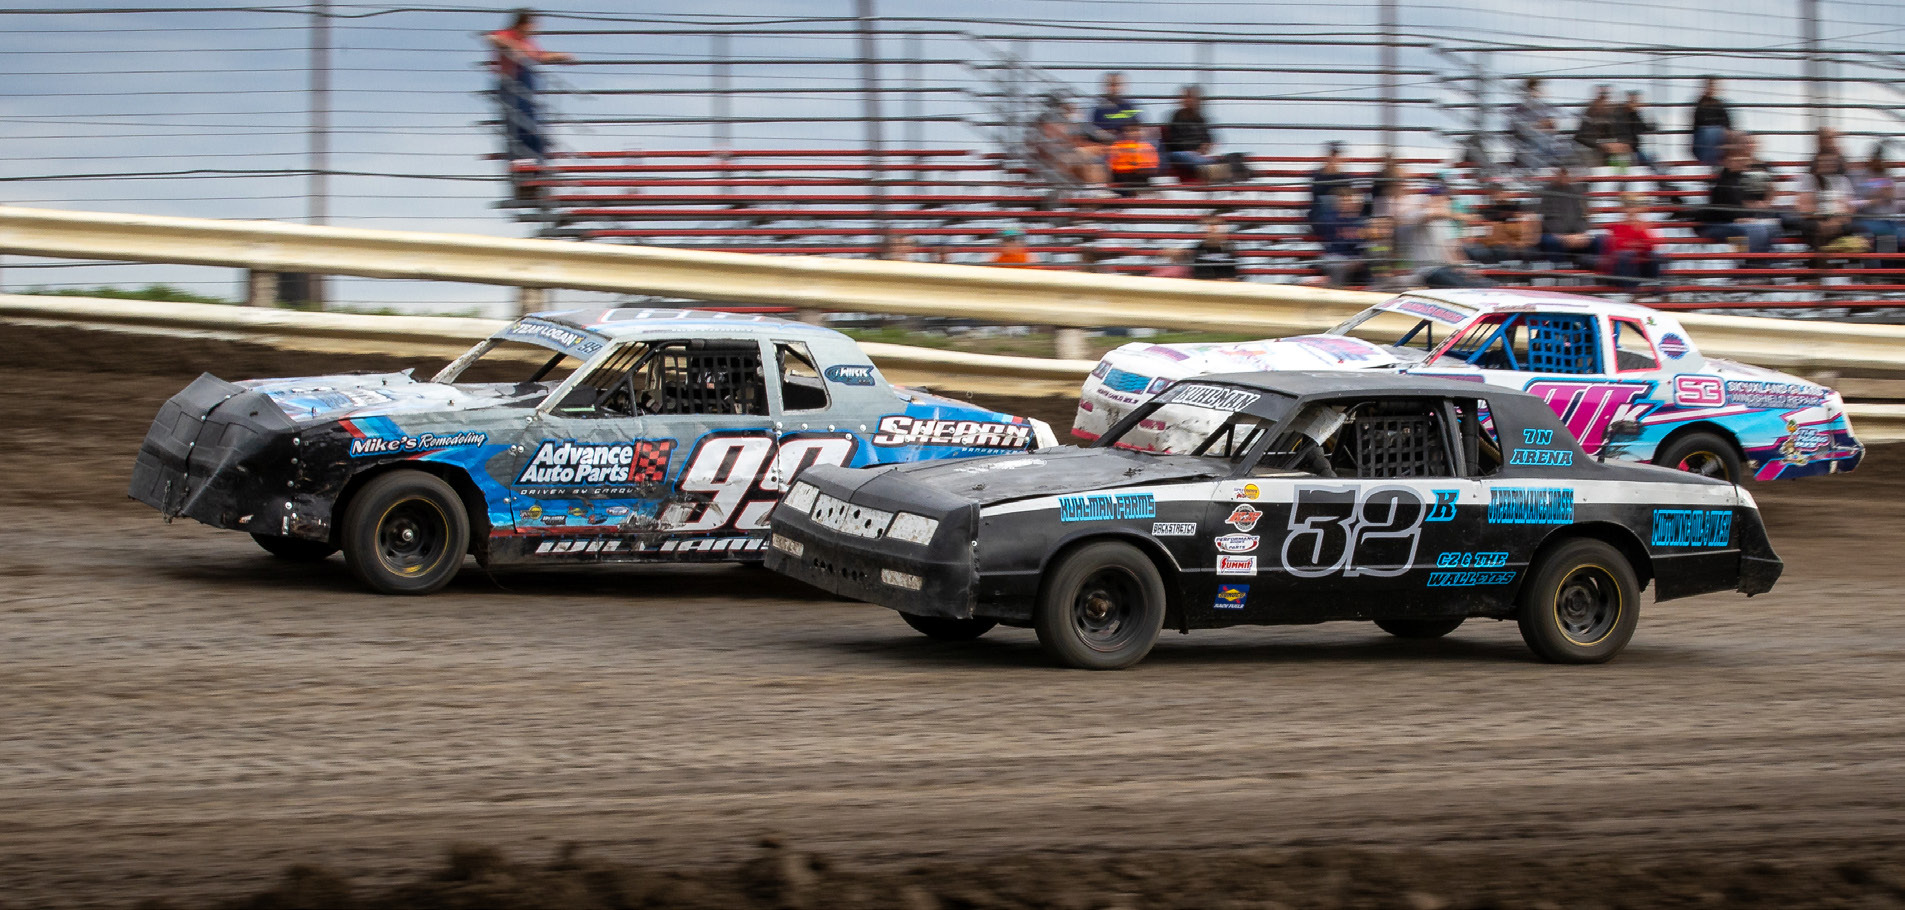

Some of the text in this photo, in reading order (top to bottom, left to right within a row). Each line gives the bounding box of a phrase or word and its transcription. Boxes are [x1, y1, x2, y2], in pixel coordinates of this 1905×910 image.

[511, 322, 578, 346] TEAM LOGAN
[1727, 381, 1787, 394] SIOUXLAND
[873, 416, 1030, 447] SHEARN
[352, 432, 485, 454] Mike's Remodeling
[532, 442, 634, 465] Advance
[1510, 448, 1573, 466] ARENA
[520, 464, 630, 483] Auto Parts
[657, 436, 850, 531] 99
[520, 488, 566, 496] DRIVEN
[1114, 492, 1156, 520] FARMS
[1425, 489, 1460, 522] K
[1152, 522, 1197, 536] BACKSTRETCH
[1281, 484, 1427, 578] 32
[1474, 552, 1509, 568] THE
[1427, 572, 1516, 586] WALLEYES
